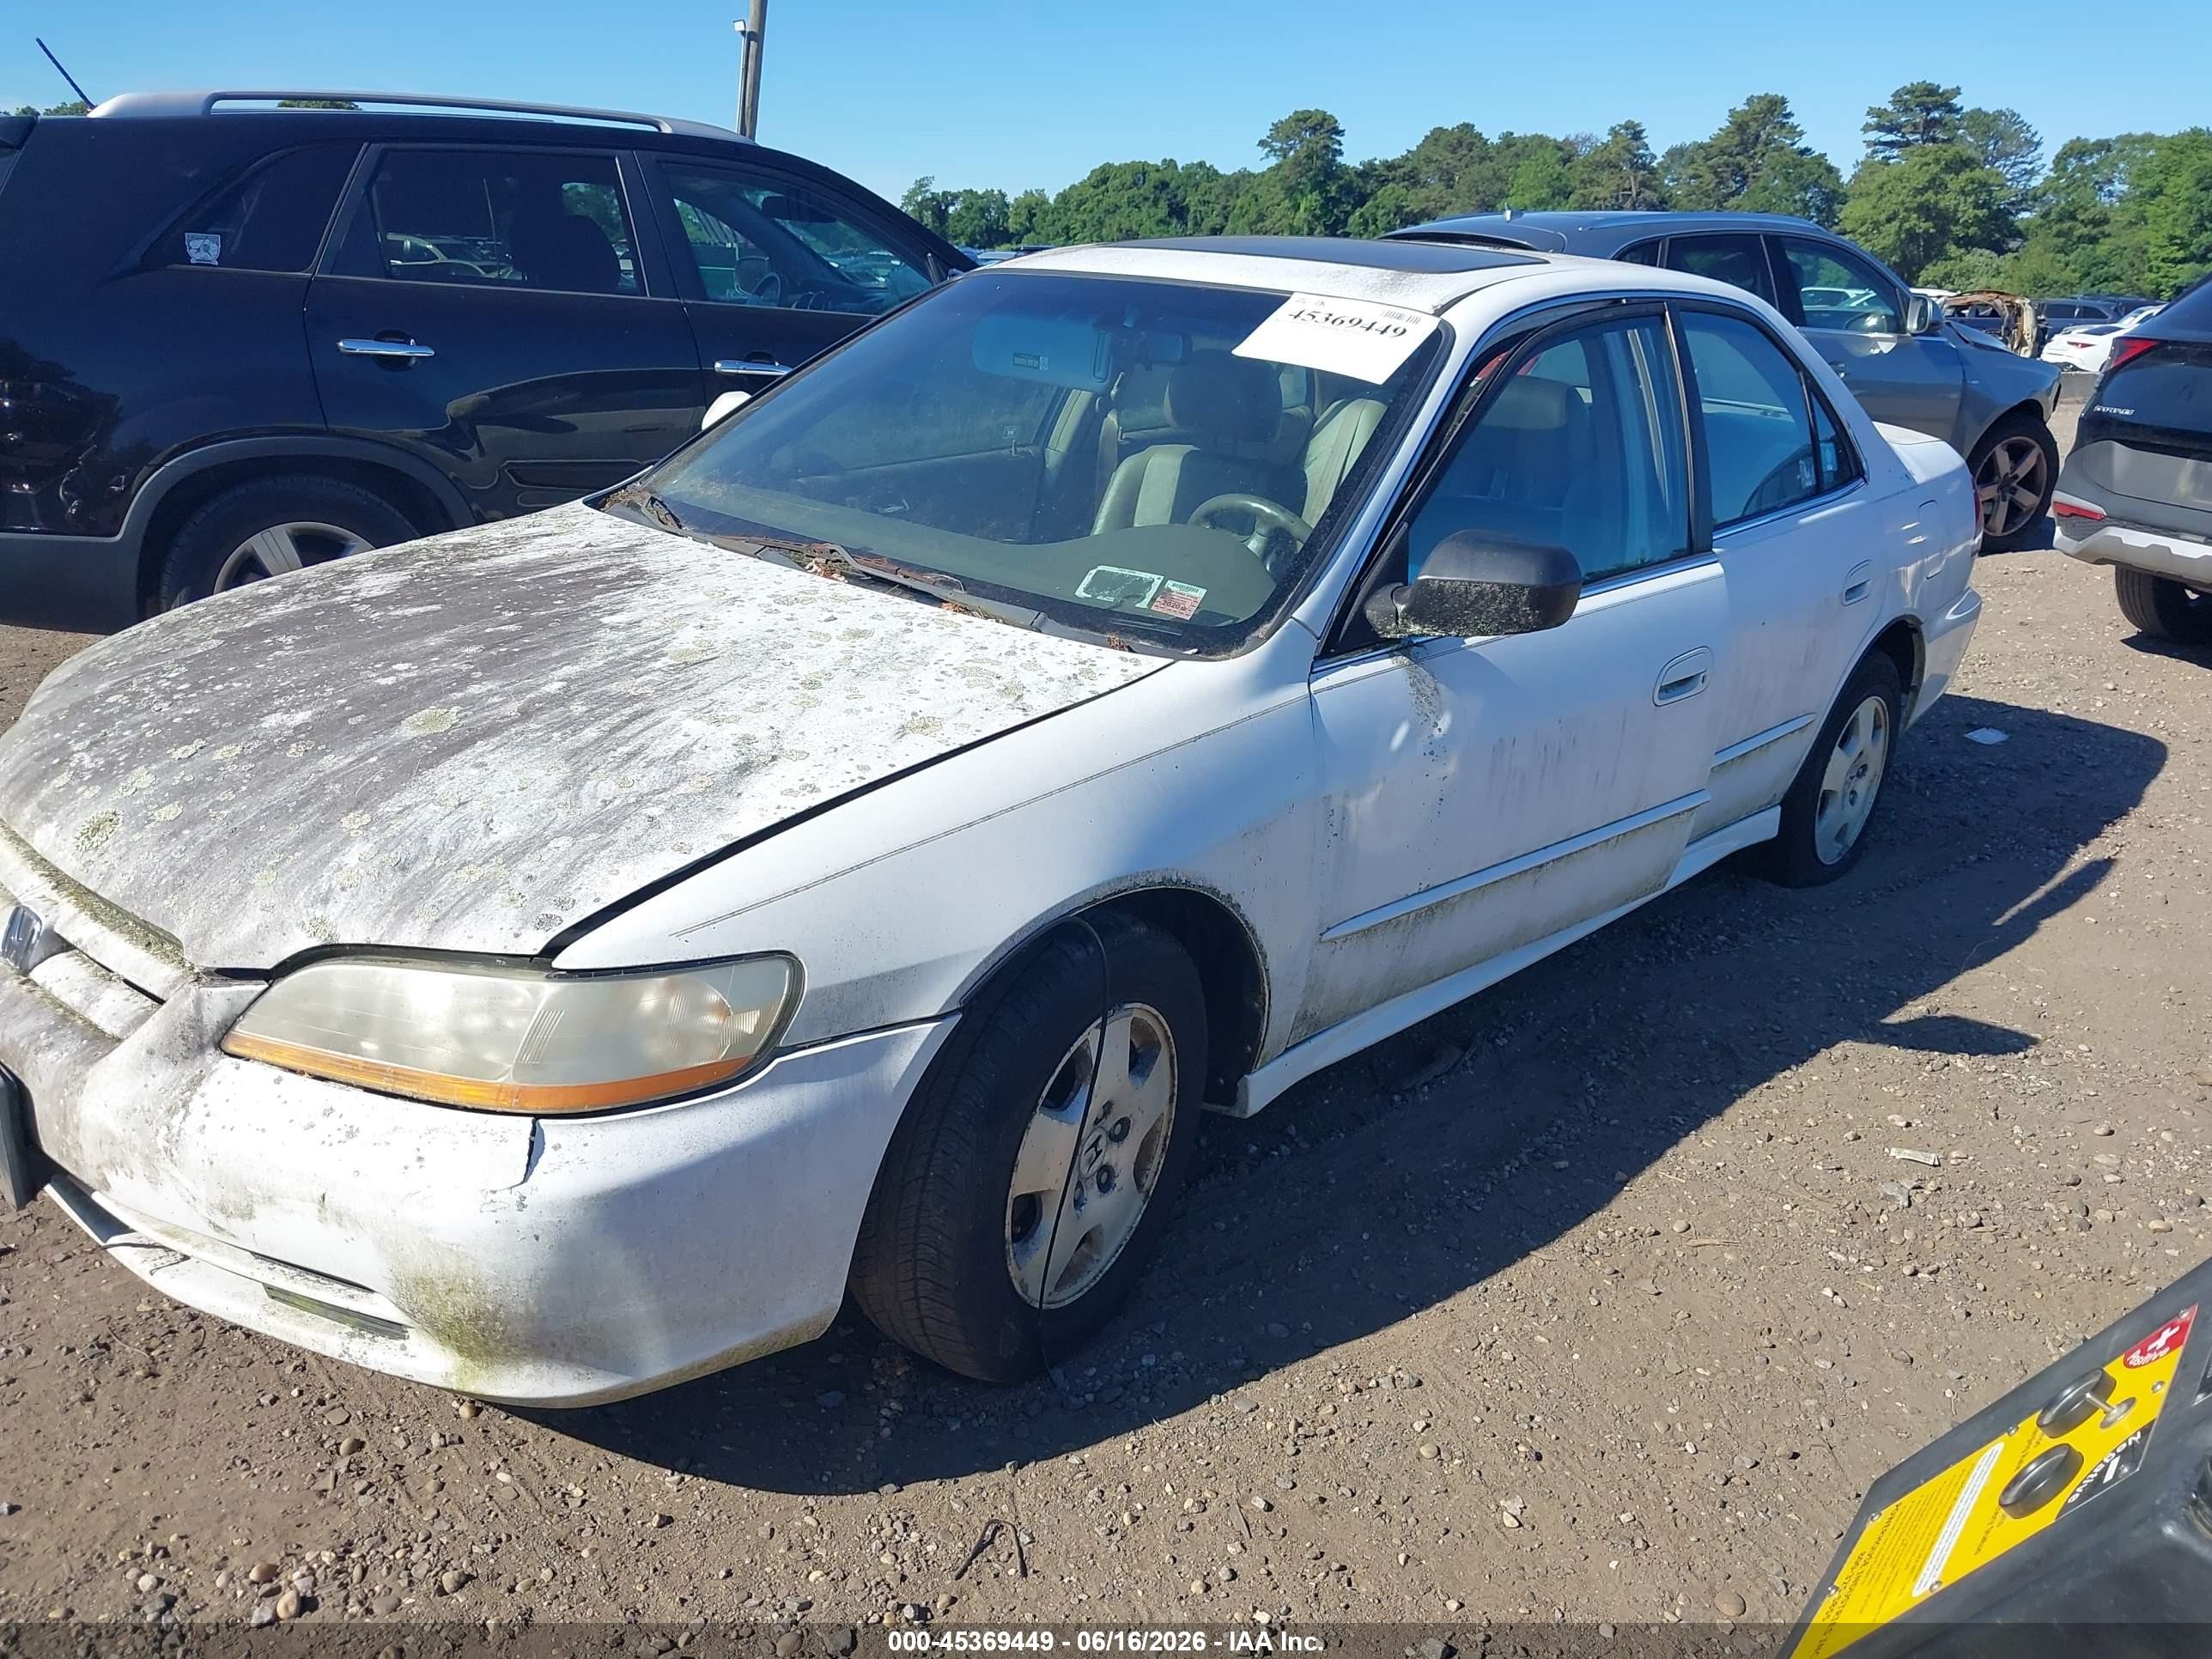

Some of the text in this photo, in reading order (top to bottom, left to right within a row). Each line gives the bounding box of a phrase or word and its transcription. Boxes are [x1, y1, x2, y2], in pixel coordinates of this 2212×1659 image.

[1289, 308, 1408, 338] 45369449
[1160, 599, 1181, 610] 2020
[2067, 1430, 2142, 1504] Negative
